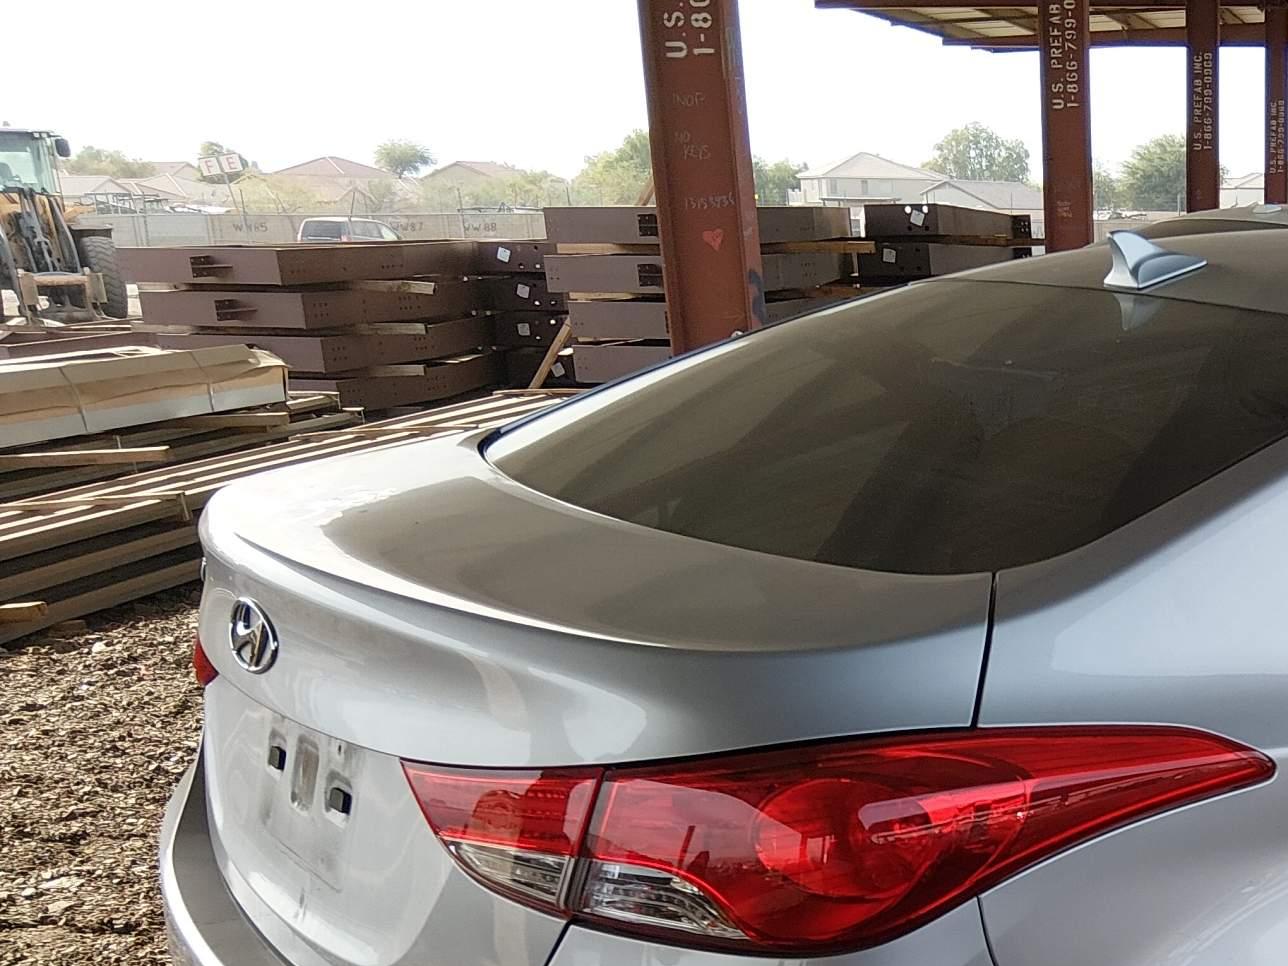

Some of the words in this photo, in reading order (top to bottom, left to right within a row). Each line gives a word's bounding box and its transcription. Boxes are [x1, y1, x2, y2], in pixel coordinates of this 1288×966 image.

[1048, 3, 1063, 69] PREFAB
[1051, 78, 1065, 110] U.S.
[1193, 79, 1203, 124] PREFAB
